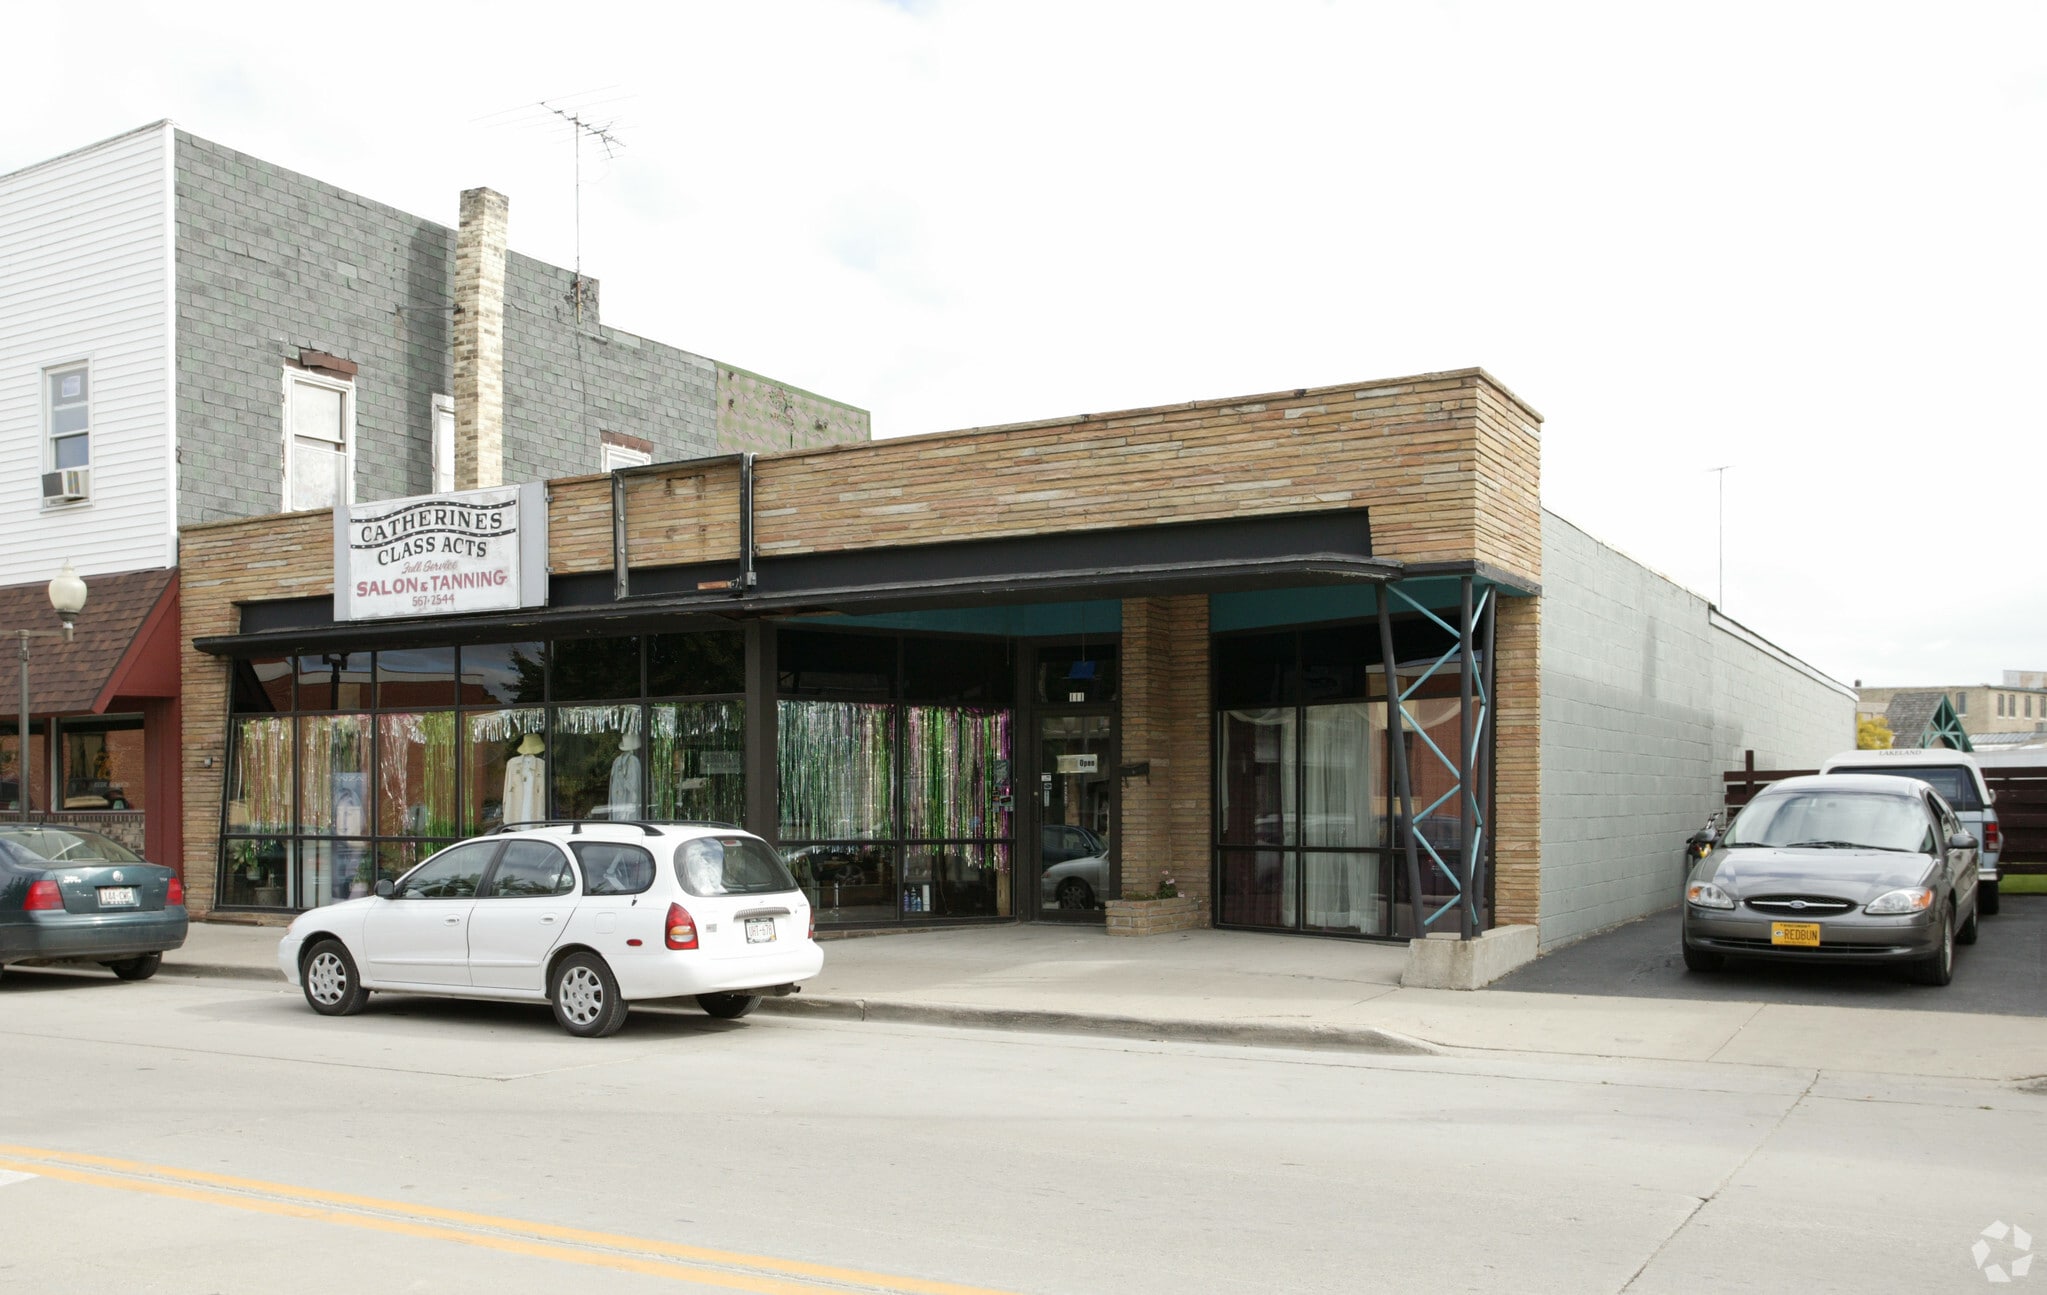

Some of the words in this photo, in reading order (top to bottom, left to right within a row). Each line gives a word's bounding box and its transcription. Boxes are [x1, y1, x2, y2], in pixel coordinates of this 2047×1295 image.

[361, 508, 502, 542] CATHERINES
[378, 536, 435, 566] CLASS
[441, 536, 487, 558] ACTS
[422, 560, 458, 573] Service
[356, 577, 418, 598] SALON
[420, 581, 428, 592] &
[430, 569, 507, 592] TANNING
[1879, 749, 1922, 757] LAKELAND
[1079, 759, 1095, 768] Open
[1784, 928, 1818, 941] REDBUN
